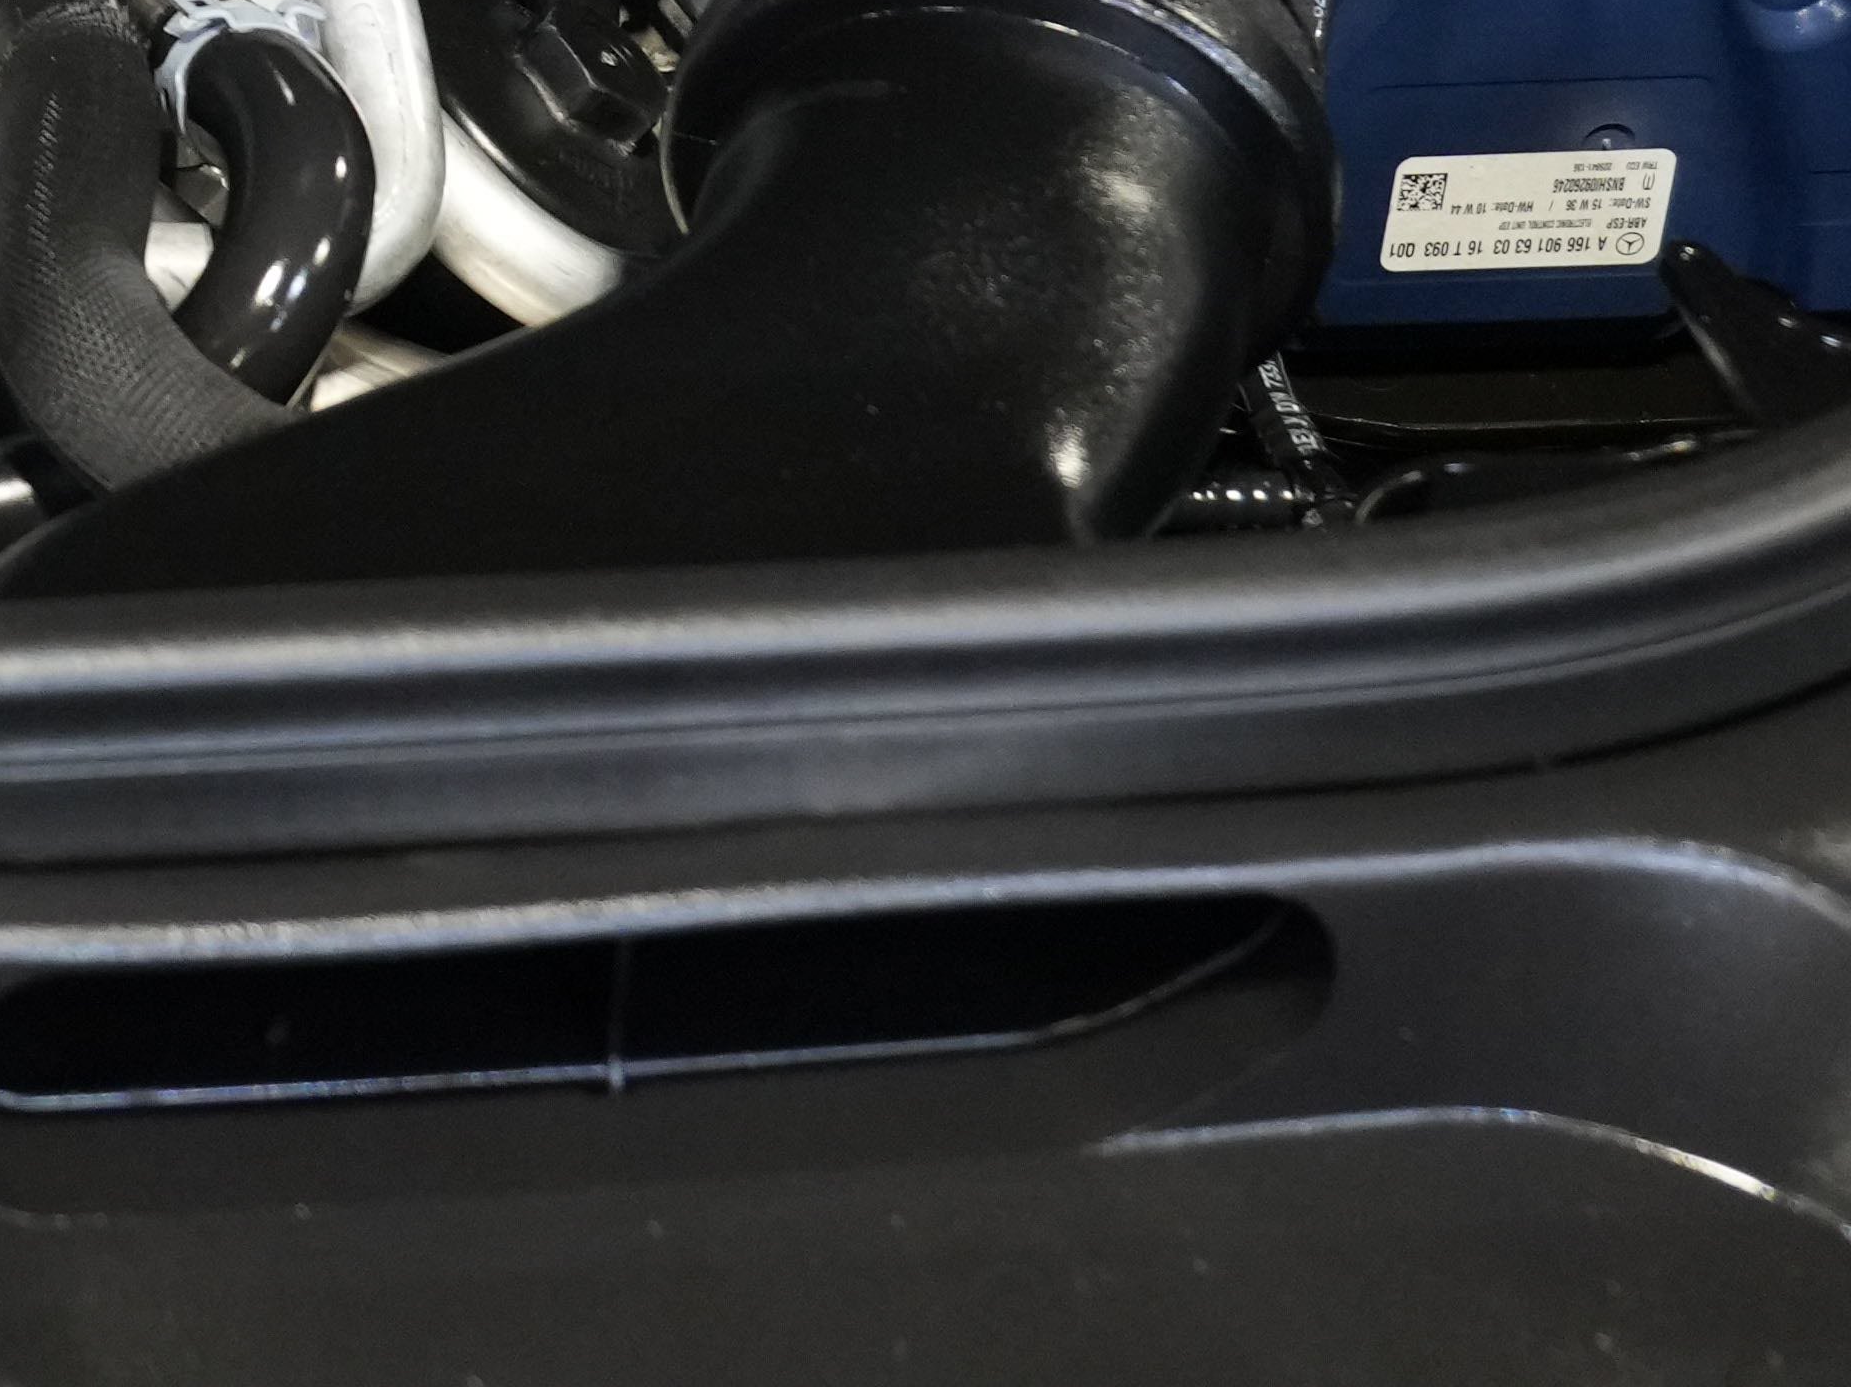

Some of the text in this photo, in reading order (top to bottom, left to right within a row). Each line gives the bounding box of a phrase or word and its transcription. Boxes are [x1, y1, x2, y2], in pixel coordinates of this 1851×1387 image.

[1642, 172, 1655, 190] (T)
[1450, 205, 1461, 215] 44
[1463, 203, 1474, 214] W
[1476, 202, 1487, 215] 10
[1491, 201, 1534, 213] HW-Date:
[1566, 199, 1577, 211] 36
[1579, 199, 1589, 210] W
[1592, 199, 1603, 210] 15
[1609, 197, 1651, 209] SW-Date:
[1606, 217, 1648, 229] ABR-ESP
[1424, 241, 1449, 257] 093
[1453, 240, 1462, 256] T
[1467, 240, 1483, 255] 16
[1493, 239, 1510, 254] 03
[1515, 238, 1532, 254] 63
[1538, 237, 1562, 253] 901
[1567, 237, 1591, 252] 166
[1599, 236, 1608, 251] A
